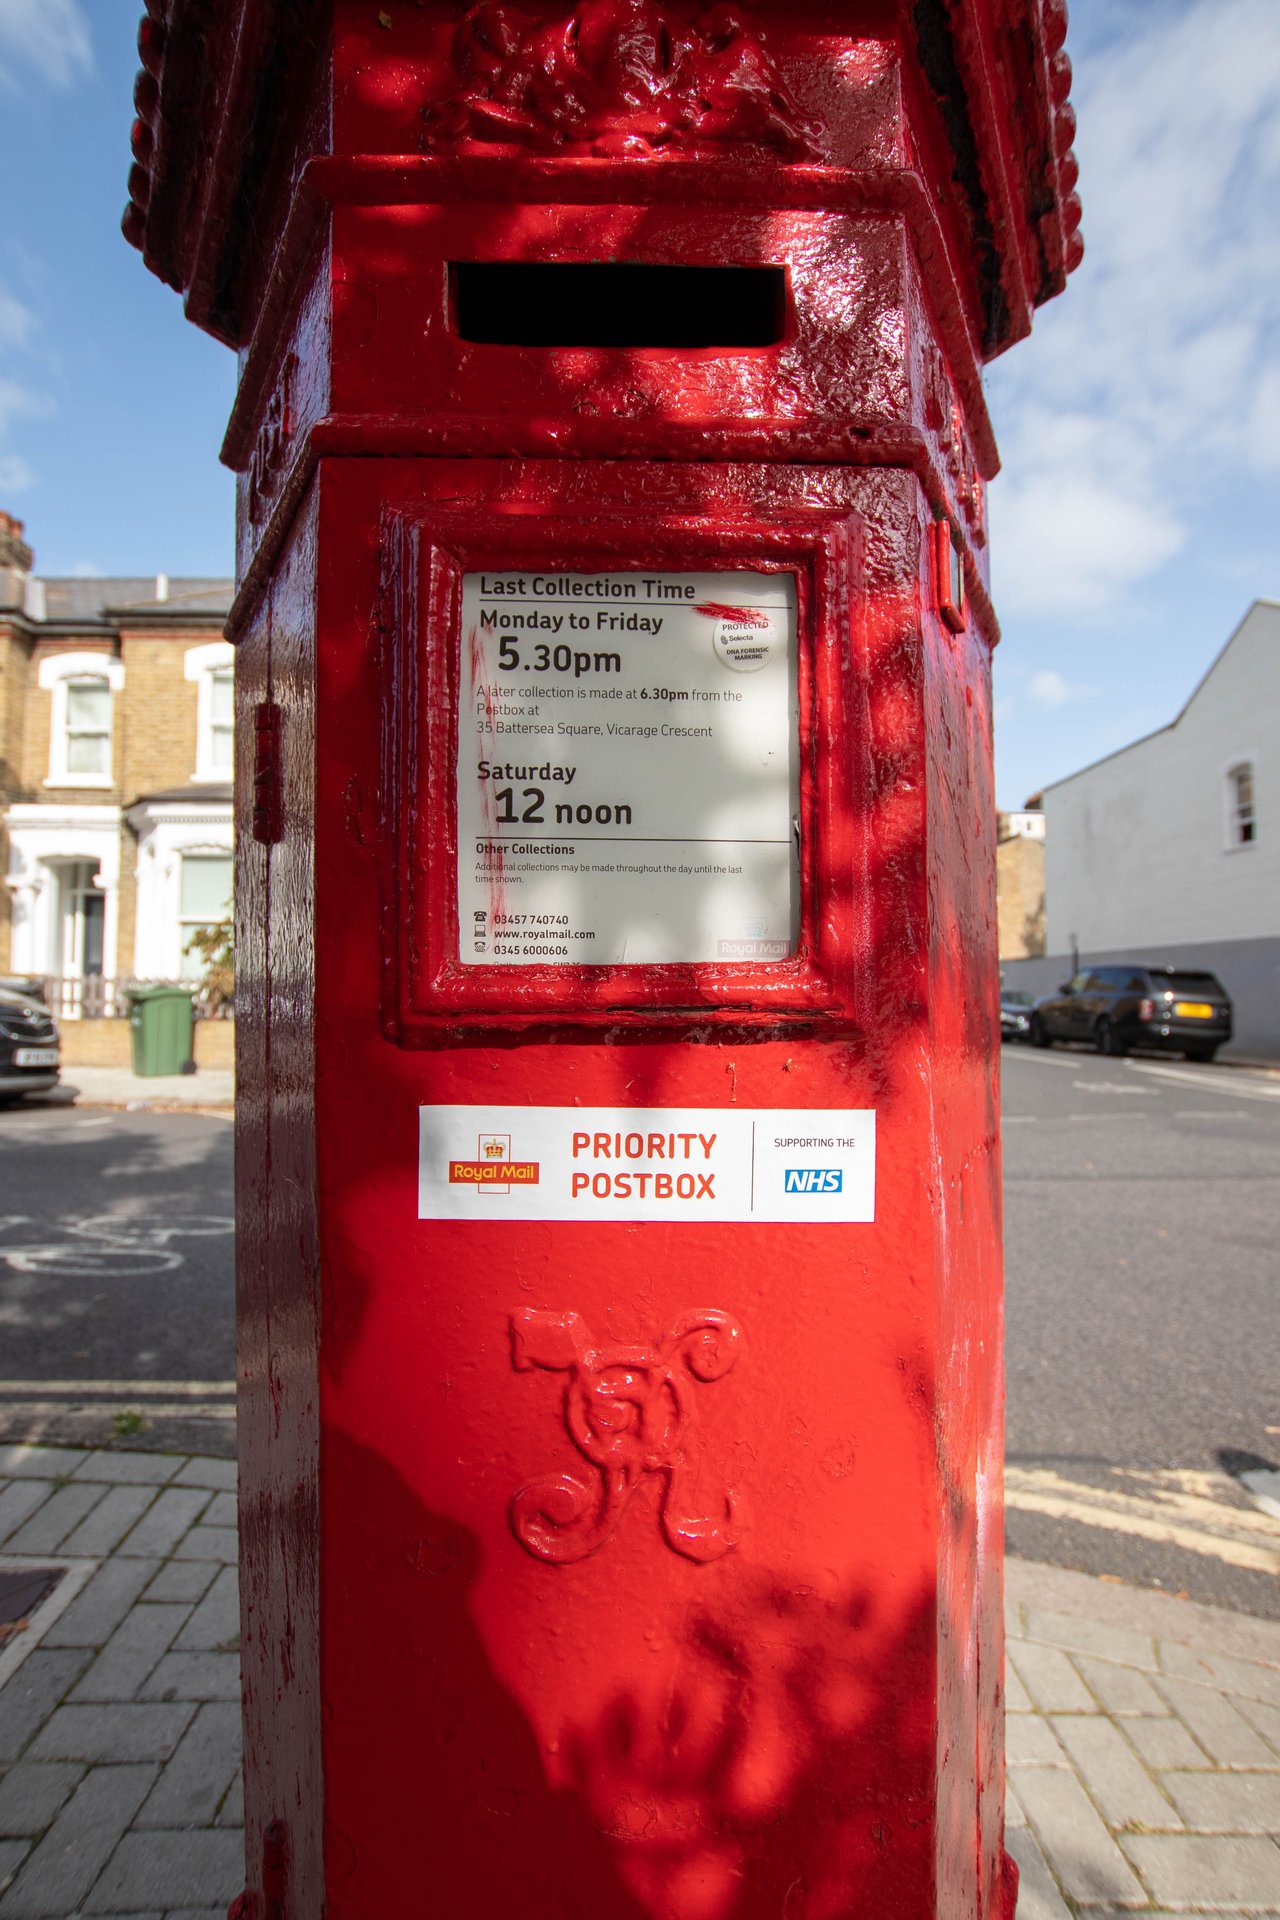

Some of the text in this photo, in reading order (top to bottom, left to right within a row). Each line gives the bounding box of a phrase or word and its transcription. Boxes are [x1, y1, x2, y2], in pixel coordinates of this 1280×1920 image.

[480, 576, 695, 599] Last Collection Time
[480, 610, 663, 636] Monday to Friday
[722, 622, 769, 631] PROTECTED
[498, 636, 621, 678] 5.30pm
[734, 653, 763, 661] MARKING
[476, 685, 743, 702] A later collection is made at 6.30pm from the
[476, 703, 540, 716] Postbox at
[476, 721, 494, 734] 35
[496, 721, 555, 735] Battersea
[606, 723, 658, 739] Vicarage
[661, 724, 713, 738] Crescent
[477, 760, 577, 785] Saturday
[495, 787, 632, 825] 12 noon
[475, 843, 575, 855] Other Collections
[475, 862, 743, 875] Additional collections may be made throughout the day until the last
[475, 875, 524, 884] time shown.
[494, 915, 569, 925] 03457 740740
[494, 929, 596, 941] www.royalmail.com
[494, 945, 568, 956] 0345 6000606
[721, 942, 787, 955] Royal Mail
[572, 1132, 717, 1160] PRIORITY
[774, 1138, 855, 1148] SUPPORTING THE
[454, 1164, 534, 1181] Royal Mail
[572, 1172, 716, 1199] POSTBOX
[786, 1171, 841, 1192] NHS
